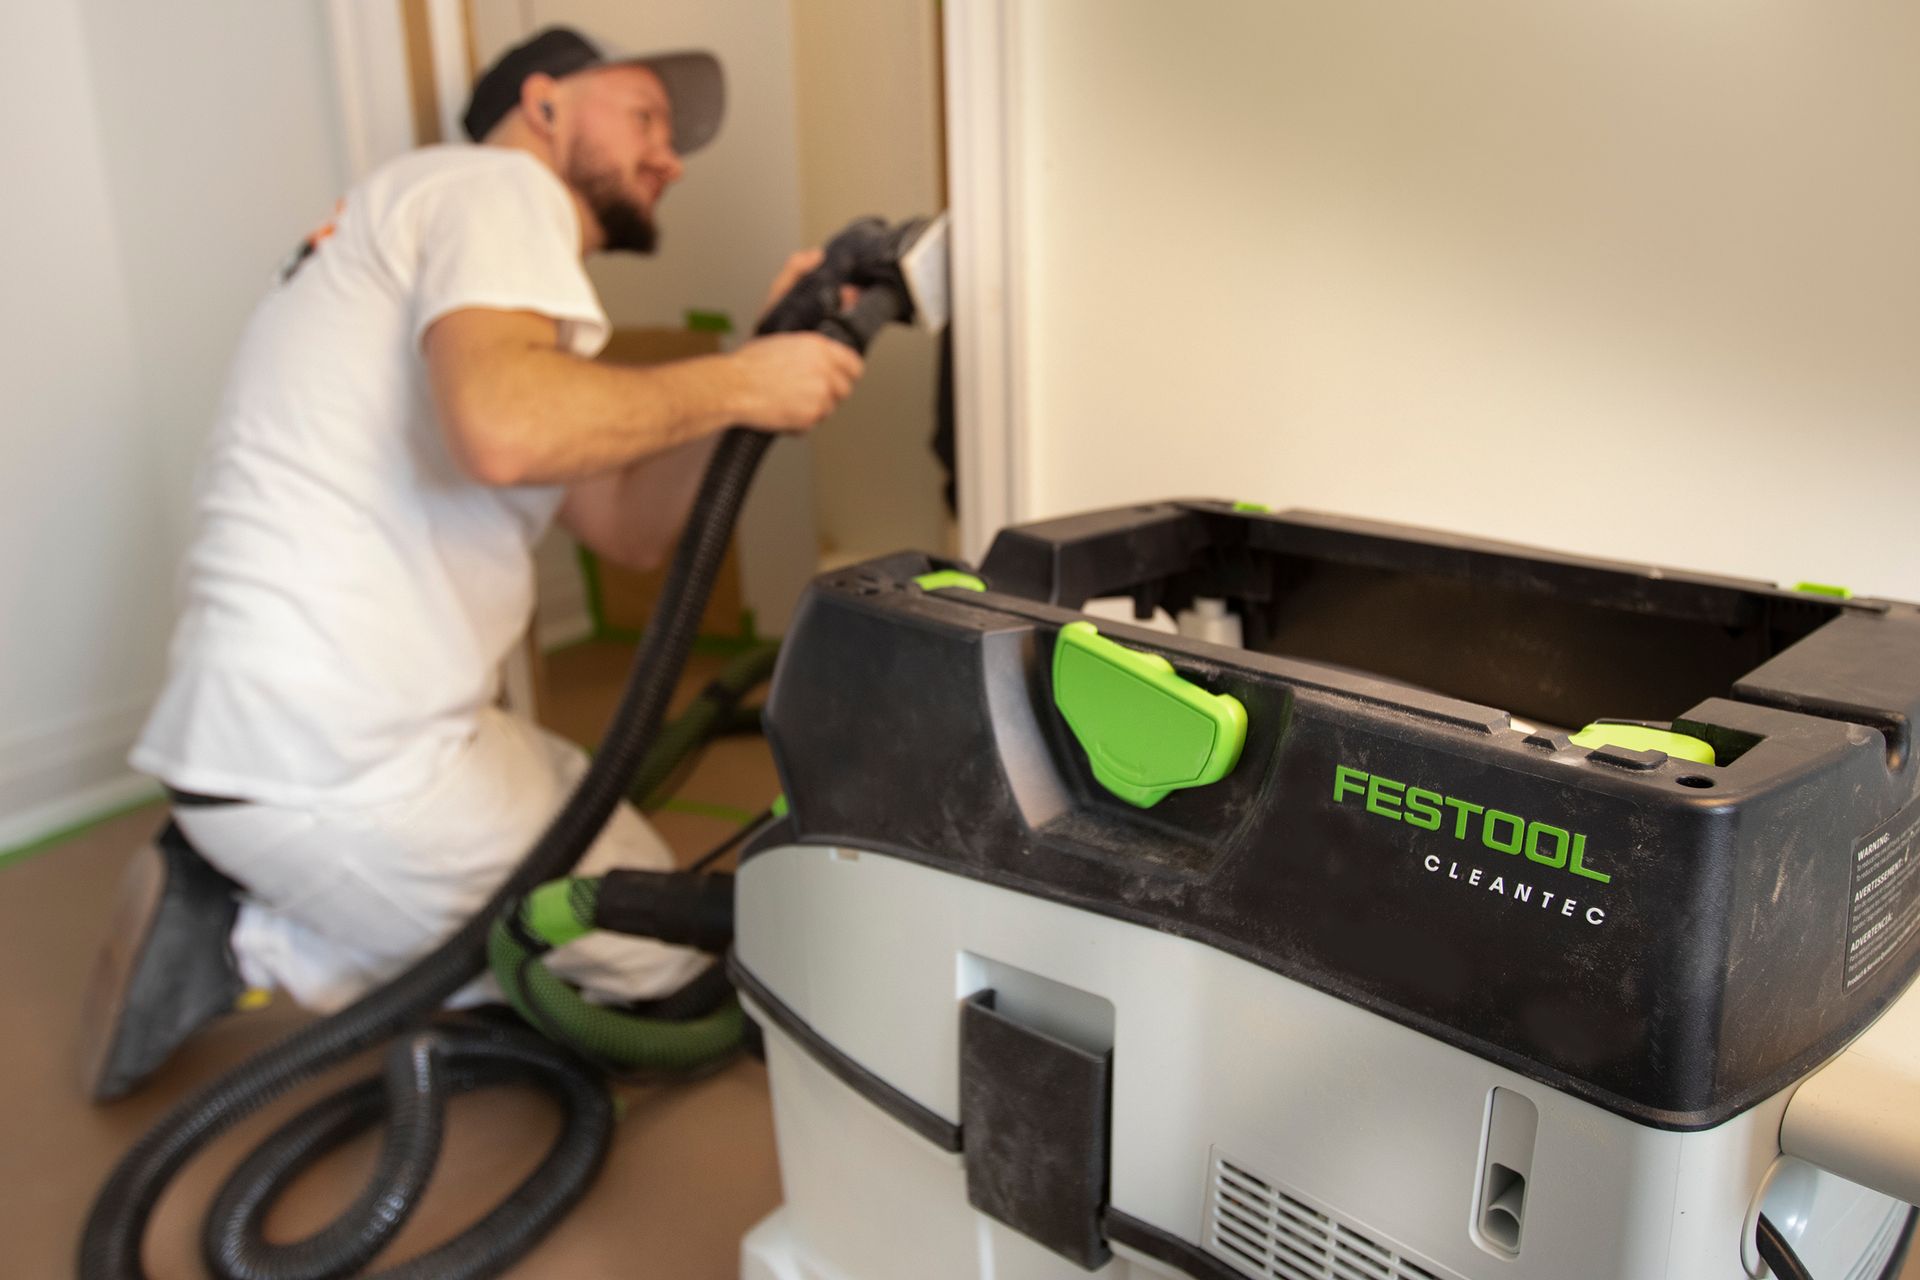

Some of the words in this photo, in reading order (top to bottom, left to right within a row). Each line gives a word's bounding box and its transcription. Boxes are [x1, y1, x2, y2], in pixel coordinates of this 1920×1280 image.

[1333, 764, 1611, 884] FESTOOL
[1857, 832, 1890, 862] WARNING:
[1424, 855, 1606, 925] CLEANTEC
[1854, 857, 1904, 903] AVERTISSEMENT:
